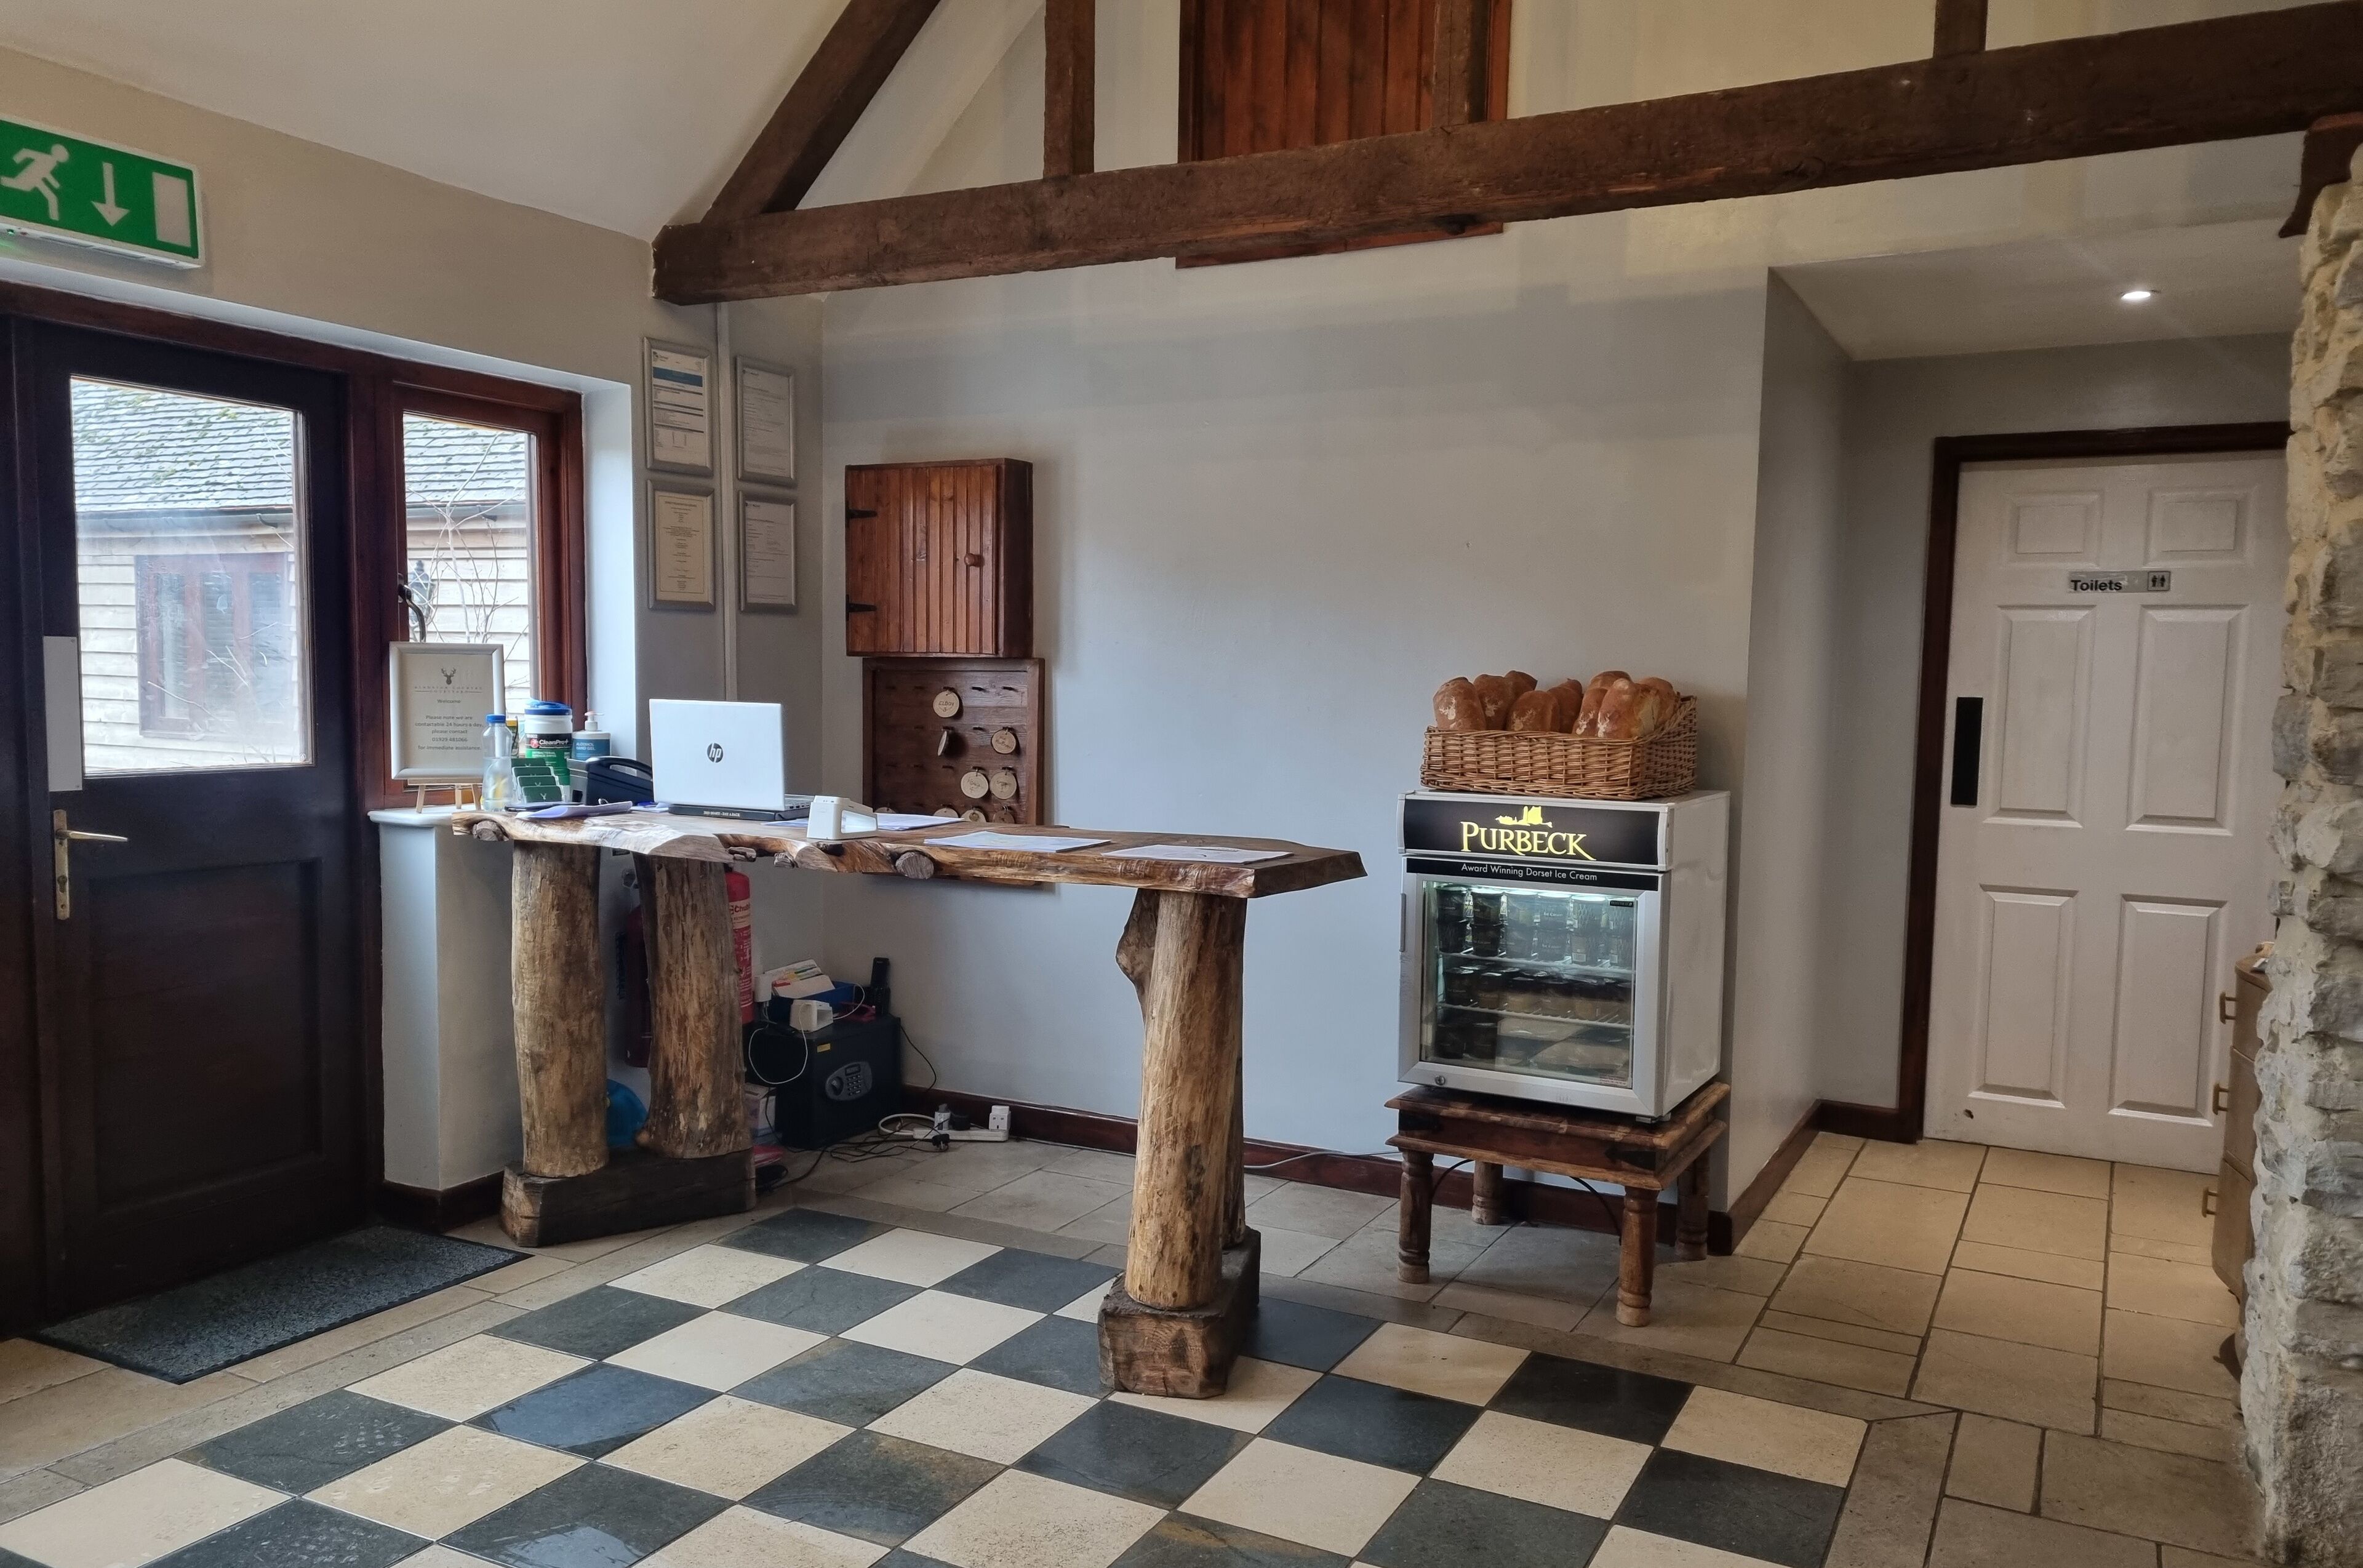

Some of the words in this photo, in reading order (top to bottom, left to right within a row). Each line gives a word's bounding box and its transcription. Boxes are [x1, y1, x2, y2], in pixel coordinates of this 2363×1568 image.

[2071, 580, 2122, 591] Toilets
[708, 742, 722, 763] hp
[1460, 822, 1596, 861] PURBECK
[1461, 863, 1488, 873] Award
[1490, 865, 1523, 877] Winning
[1526, 868, 1552, 878] Dorset
[1555, 870, 1567, 879] Ice
[1569, 871, 1597, 881] Cream
